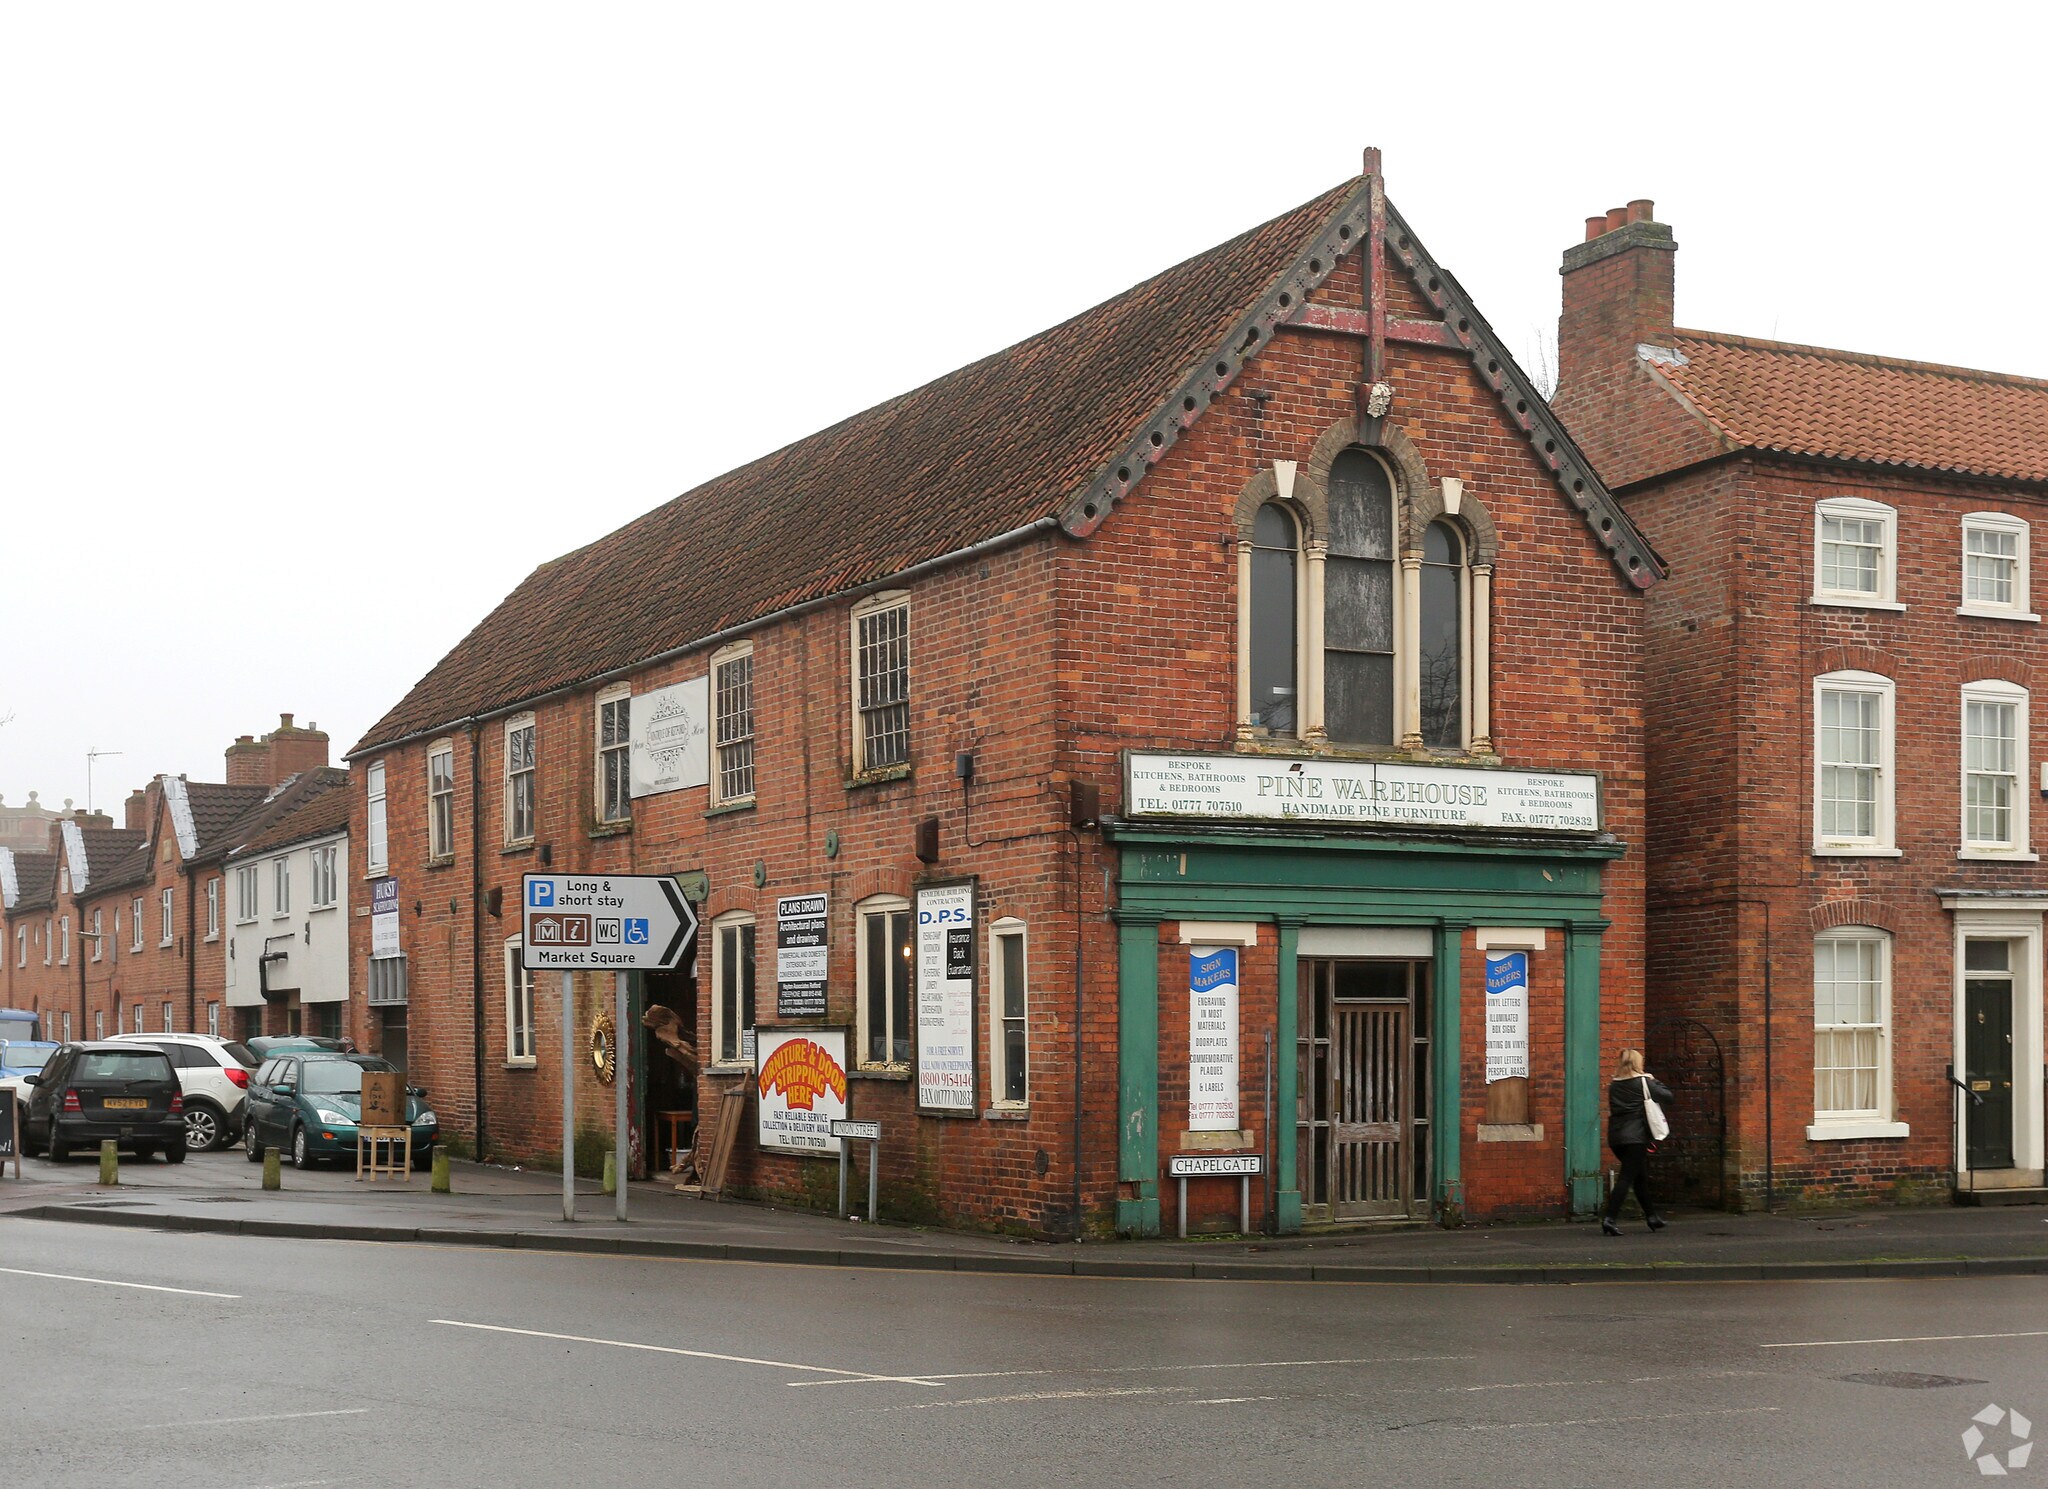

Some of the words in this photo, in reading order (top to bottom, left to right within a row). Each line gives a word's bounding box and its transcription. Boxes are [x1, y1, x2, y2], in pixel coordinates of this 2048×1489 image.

[1168, 760, 1212, 771] BESPOKE
[1133, 770, 1185, 783] KITCHENS,
[1188, 772, 1246, 784] BATHROOMS
[1527, 778, 1565, 788] BESPOKE
[1159, 784, 1166, 792] &
[1168, 784, 1221, 794] BEDROOMS
[1257, 774, 1324, 799] PINE
[1331, 778, 1488, 807] WAREHOUSE
[1497, 787, 1542, 800] KITCHENS,
[1544, 789, 1596, 800] BATHROOMS
[1138, 798, 1168, 810] TEL:
[1171, 799, 1200, 812] 01777
[1205, 800, 1242, 813] 707510
[1519, 799, 1526, 807] &
[1527, 800, 1573, 810] BEDROOMS
[1281, 802, 1354, 817] HANDMADE
[1358, 806, 1390, 818] PINE
[1393, 807, 1467, 821] FURNITURE
[1501, 812, 1526, 824] FAX:
[1529, 813, 1555, 826] 01777
[1558, 814, 1592, 826] 702832
[376, 880, 396, 900] HURST
[567, 880, 598, 894] Long
[602, 881, 611, 892] &
[920, 888, 946, 898] REMEDIAL
[946, 886, 972, 896] BUILDING
[534, 883, 551, 905] P
[558, 895, 592, 906] short
[598, 896, 624, 908] stay
[780, 901, 801, 914] PLANS
[802, 899, 824, 912] DRAWN
[926, 896, 964, 906] CONTRACTORS
[919, 907, 973, 925] D.P.S.
[599, 924, 618, 938] WC
[780, 920, 810, 932] Architectural
[811, 920, 825, 932] plans
[786, 935, 796, 944] and
[796, 934, 819, 945] drawings
[948, 932, 970, 945] Insurance
[539, 952, 584, 963] Market
[590, 952, 636, 964] Square
[808, 950, 826, 958] DOMESTIC
[952, 947, 966, 960] Back
[947, 964, 972, 976] Guarantee
[1200, 958, 1222, 974] SIGN
[1494, 960, 1513, 976] SIGN
[1194, 968, 1231, 987] MAKERS
[1488, 970, 1522, 988] MAKERS
[1198, 997, 1226, 1006] ENGRAVING
[1487, 998, 1501, 1008] VINYL
[1502, 998, 1521, 1008] LETTERS
[1200, 1009, 1206, 1018] IN
[1208, 1009, 1222, 1018] MOST
[1489, 1013, 1518, 1023] ILLUMINATED
[1198, 1021, 1226, 1030] MATERIALS
[1492, 1025, 1502, 1034] BOX
[1502, 1025, 1516, 1034] SIGNS
[1196, 1037, 1228, 1047] DOORPLATES
[1504, 1041, 1512, 1049] ON
[947, 1046, 964, 1056] SURVEY
[1190, 1054, 1234, 1064] COMMEMORATIVE
[1504, 1056, 1522, 1065] LETTERS
[760, 1043, 807, 1094] FURNITURE
[809, 1047, 816, 1066] &
[819, 1052, 846, 1098] DOOR
[1200, 1066, 1223, 1076] PLAQUES
[776, 1065, 826, 1092] STRIPPING
[920, 1072, 940, 1086] 0800
[941, 1073, 972, 1087] 9154146
[1199, 1083, 1204, 1092] &
[1204, 1082, 1224, 1092] LABELS
[788, 1086, 812, 1105] HERE
[920, 1088, 934, 1104] FAX
[934, 1089, 950, 1104] 01777
[952, 1090, 973, 1106] 702832
[1190, 1102, 1198, 1111] Tel
[1198, 1102, 1214, 1110] 01777
[1215, 1102, 1233, 1110] 707510
[774, 1110, 784, 1119] FAST
[784, 1112, 807, 1122] RELIABLE
[808, 1114, 828, 1122] SERVICE
[1198, 1111, 1214, 1120] 01777
[1216, 1110, 1235, 1120] 702832
[762, 1121, 788, 1130] COLLECTION
[788, 1124, 792, 1132] &
[792, 1124, 816, 1133] DELIVERY
[816, 1125, 830, 1134] AVAIL
[834, 1123, 854, 1136] UNION
[856, 1124, 878, 1136] STREET
[779, 1135, 790, 1144] TEL:
[791, 1136, 806, 1146] 01777
[807, 1138, 826, 1148] 707510
[1176, 1158, 1257, 1172] CHAPELGATE
